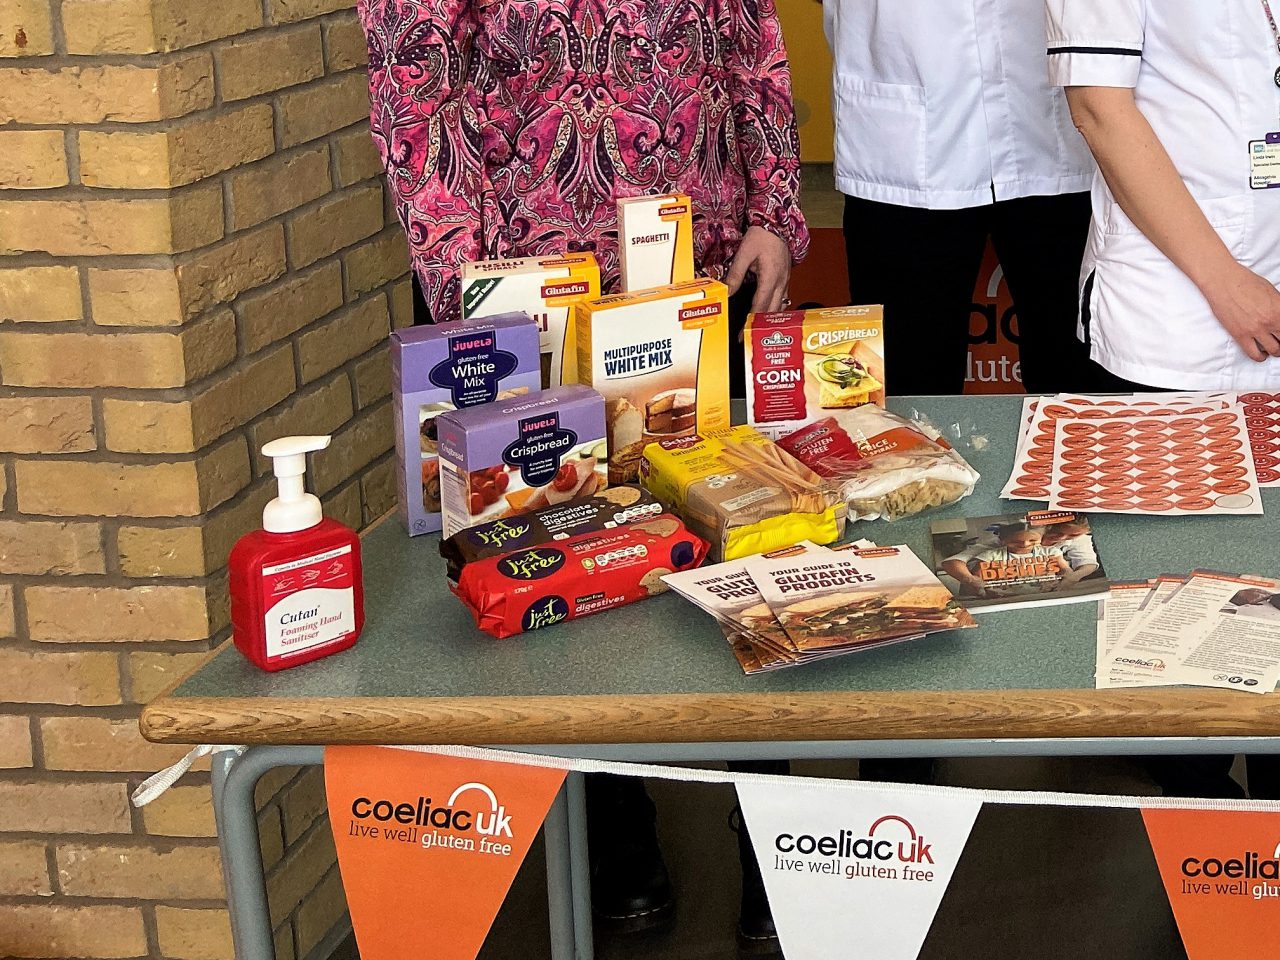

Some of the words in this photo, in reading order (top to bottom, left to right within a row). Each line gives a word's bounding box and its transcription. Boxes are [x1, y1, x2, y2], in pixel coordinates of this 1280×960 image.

[661, 207, 685, 215] Glutafin
[632, 233, 670, 246] SPAGHETTI
[546, 285, 585, 296] Glutafin
[682, 306, 718, 318] Glutafin
[604, 339, 672, 361] MULTIPURPOSE
[765, 352, 791, 360] GLUTEN
[452, 363, 496, 379] White
[604, 356, 647, 376] WHITE
[649, 350, 673, 367] MIX
[464, 376, 485, 389] Mix
[756, 369, 801, 384] CORN
[502, 398, 559, 415] Crispbread
[511, 435, 570, 458] Crispbread
[866, 439, 890, 455] RICE
[539, 504, 591, 522] chocolate
[543, 507, 599, 526] digestives
[490, 524, 529, 548] free
[572, 533, 631, 552] digestives
[519, 554, 562, 578] free
[769, 567, 800, 577] YOUR
[802, 564, 835, 572] GUIDE
[982, 562, 1061, 581] DISHES
[694, 577, 724, 586] YOUR
[774, 567, 860, 586] GLUTAFIN
[778, 573, 876, 594] PRODUCTS
[576, 595, 625, 612] digestives
[529, 598, 558, 629] just
[281, 621, 318, 637] Foaming
[320, 612, 342, 626] Hand
[281, 630, 320, 647] Sanitiser
[351, 796, 472, 833] coeliac
[476, 806, 514, 839] uk
[349, 820, 379, 839] live
[383, 825, 418, 844] well
[421, 829, 476, 855] gluten
[479, 835, 512, 857] free
[775, 829, 894, 861] coeliac
[898, 834, 935, 865] uk
[774, 854, 804, 872] live
[807, 857, 841, 876] well
[845, 860, 899, 882] gluten
[902, 863, 934, 882] free
[1181, 878, 1211, 896] live
[1214, 879, 1249, 897] well
